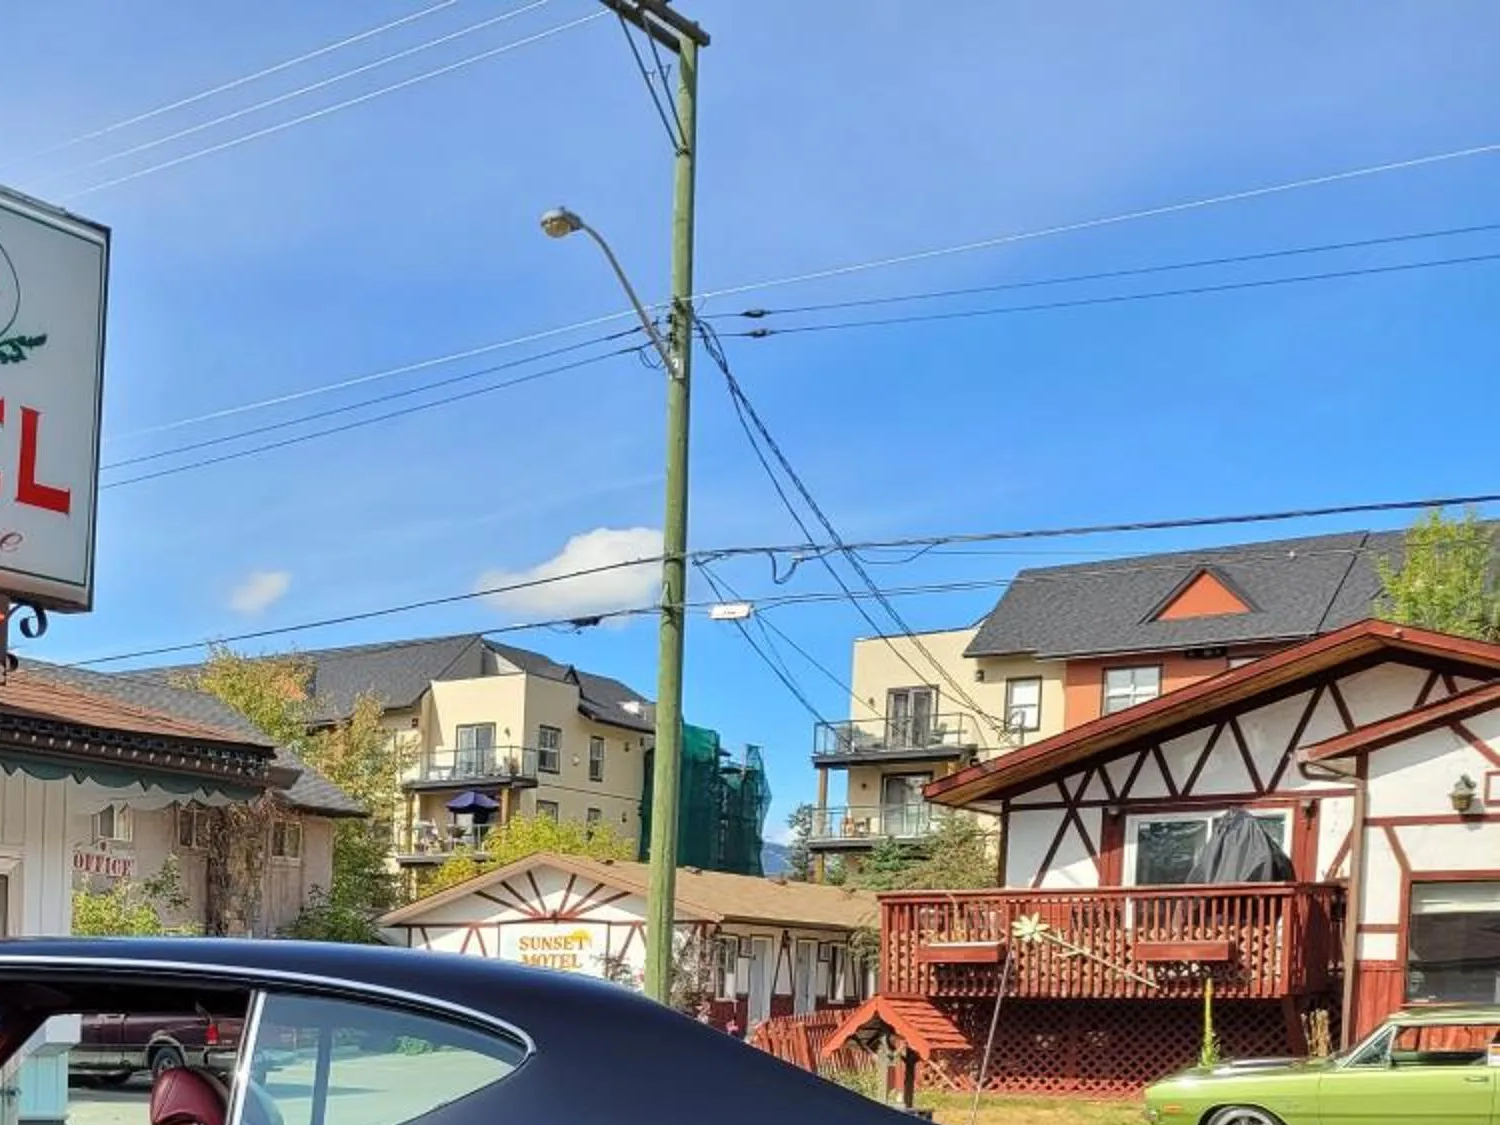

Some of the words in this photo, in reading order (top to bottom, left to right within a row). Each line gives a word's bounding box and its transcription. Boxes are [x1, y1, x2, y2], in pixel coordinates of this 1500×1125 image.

[73, 853, 135, 877] OFFICE
[518, 935, 587, 951] SUNSET
[521, 953, 582, 969] MOTEL
